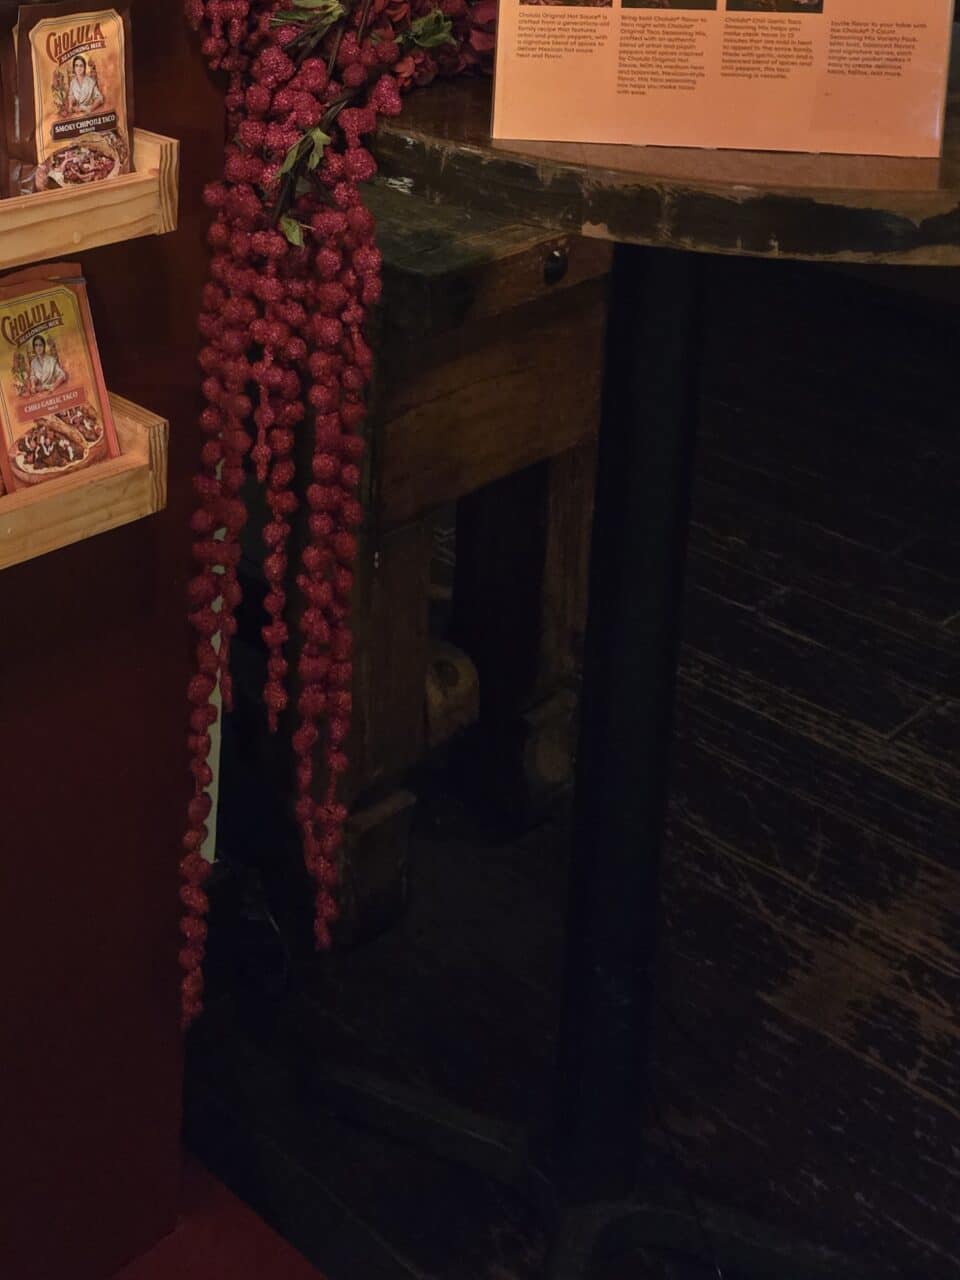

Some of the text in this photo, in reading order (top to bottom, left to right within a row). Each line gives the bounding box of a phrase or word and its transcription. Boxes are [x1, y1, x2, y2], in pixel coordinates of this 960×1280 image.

[46, 23, 105, 63] CHOLULA
[55, 114, 115, 134] SMOKY CHIPOTLE TACO
[1, 300, 62, 344] CHOLULA
[24, 391, 79, 414] CHILI GARLIC TACO
